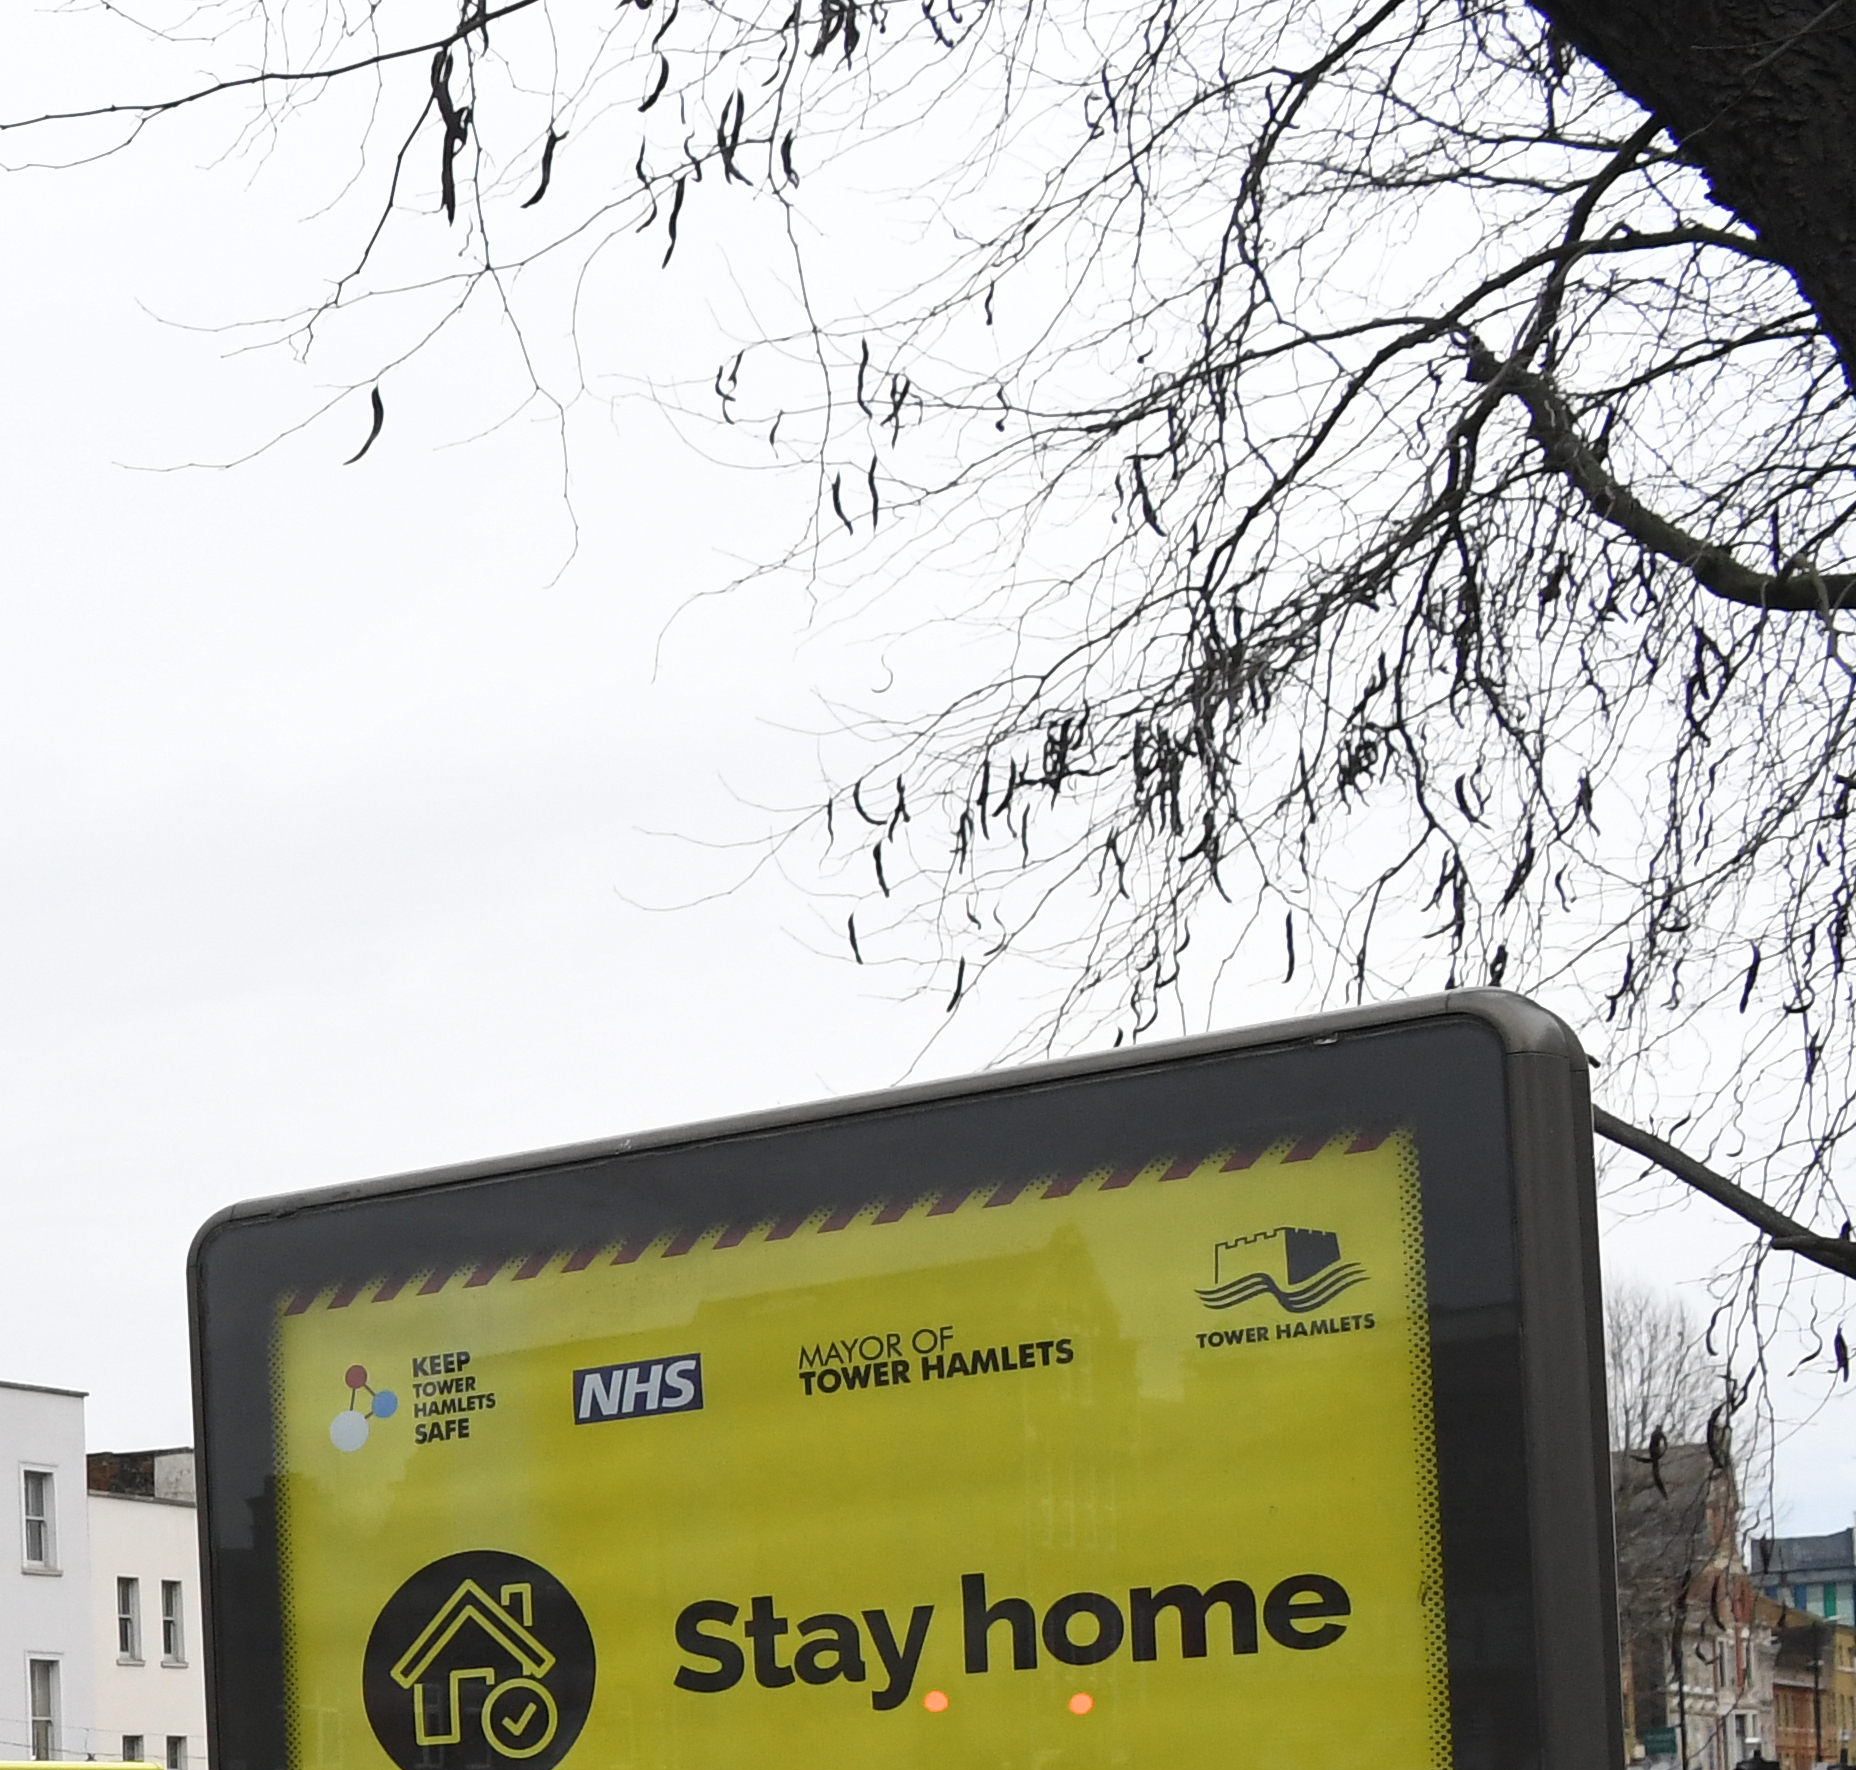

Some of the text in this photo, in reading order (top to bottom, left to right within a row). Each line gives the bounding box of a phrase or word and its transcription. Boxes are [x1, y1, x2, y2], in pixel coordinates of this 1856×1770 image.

[799, 1325, 954, 1370] MAYOR OF
[1196, 1313, 1375, 1349] TOWER HAMLETS
[412, 1351, 471, 1378] KEEP
[800, 1339, 1074, 1395] TOWER HAMLETS
[412, 1375, 476, 1398] TOWER
[577, 1357, 698, 1422] NHS
[413, 1393, 496, 1418] HAMLETS
[414, 1418, 470, 1445] SAFE
[673, 1572, 1352, 1710] Stay home
